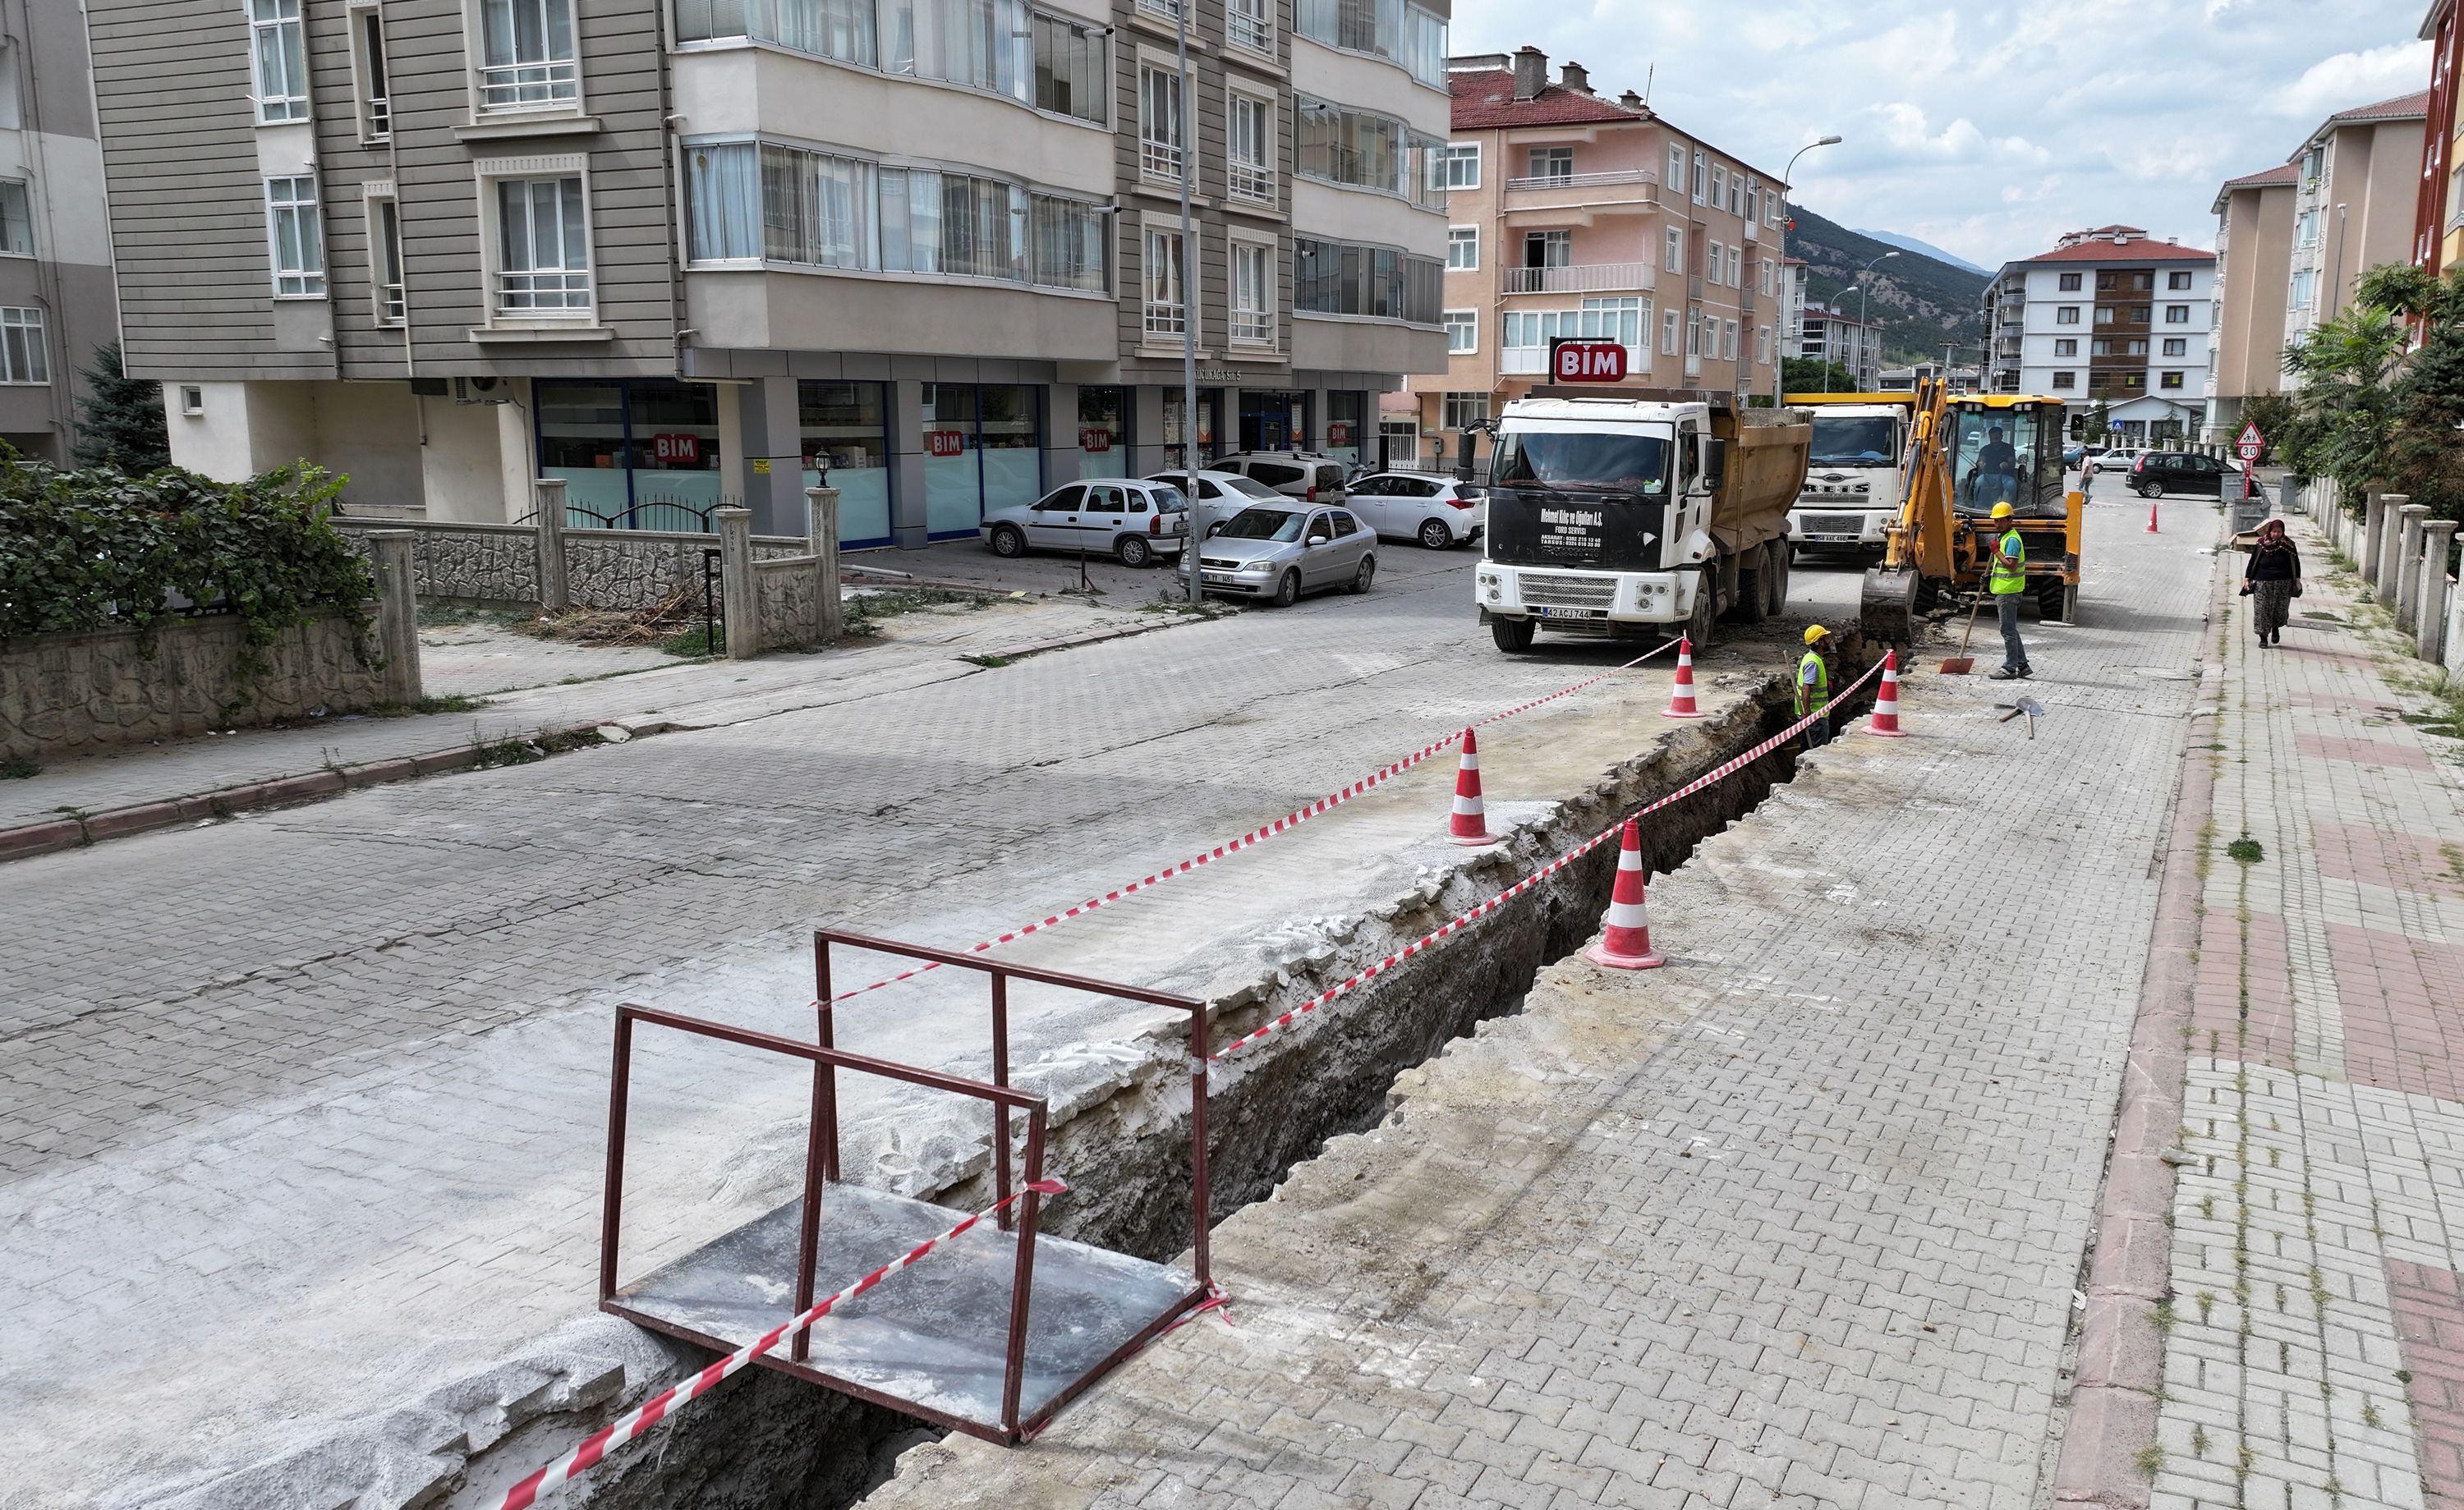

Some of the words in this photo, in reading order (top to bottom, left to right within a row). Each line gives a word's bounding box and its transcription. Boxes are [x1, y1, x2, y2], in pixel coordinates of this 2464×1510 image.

[1561, 346, 1617, 375] BİM
[1087, 429, 1107, 448] BİM
[1332, 425, 1345, 439] BİM
[658, 434, 694, 457] BİM
[934, 431, 960, 452] BİM
[2243, 447, 2256, 456] 30
[1555, 526, 1567, 534] FORD
[1547, 608, 1558, 617] 42
[1559, 609, 1573, 617] ACJ
[1574, 610, 1589, 618] 744
